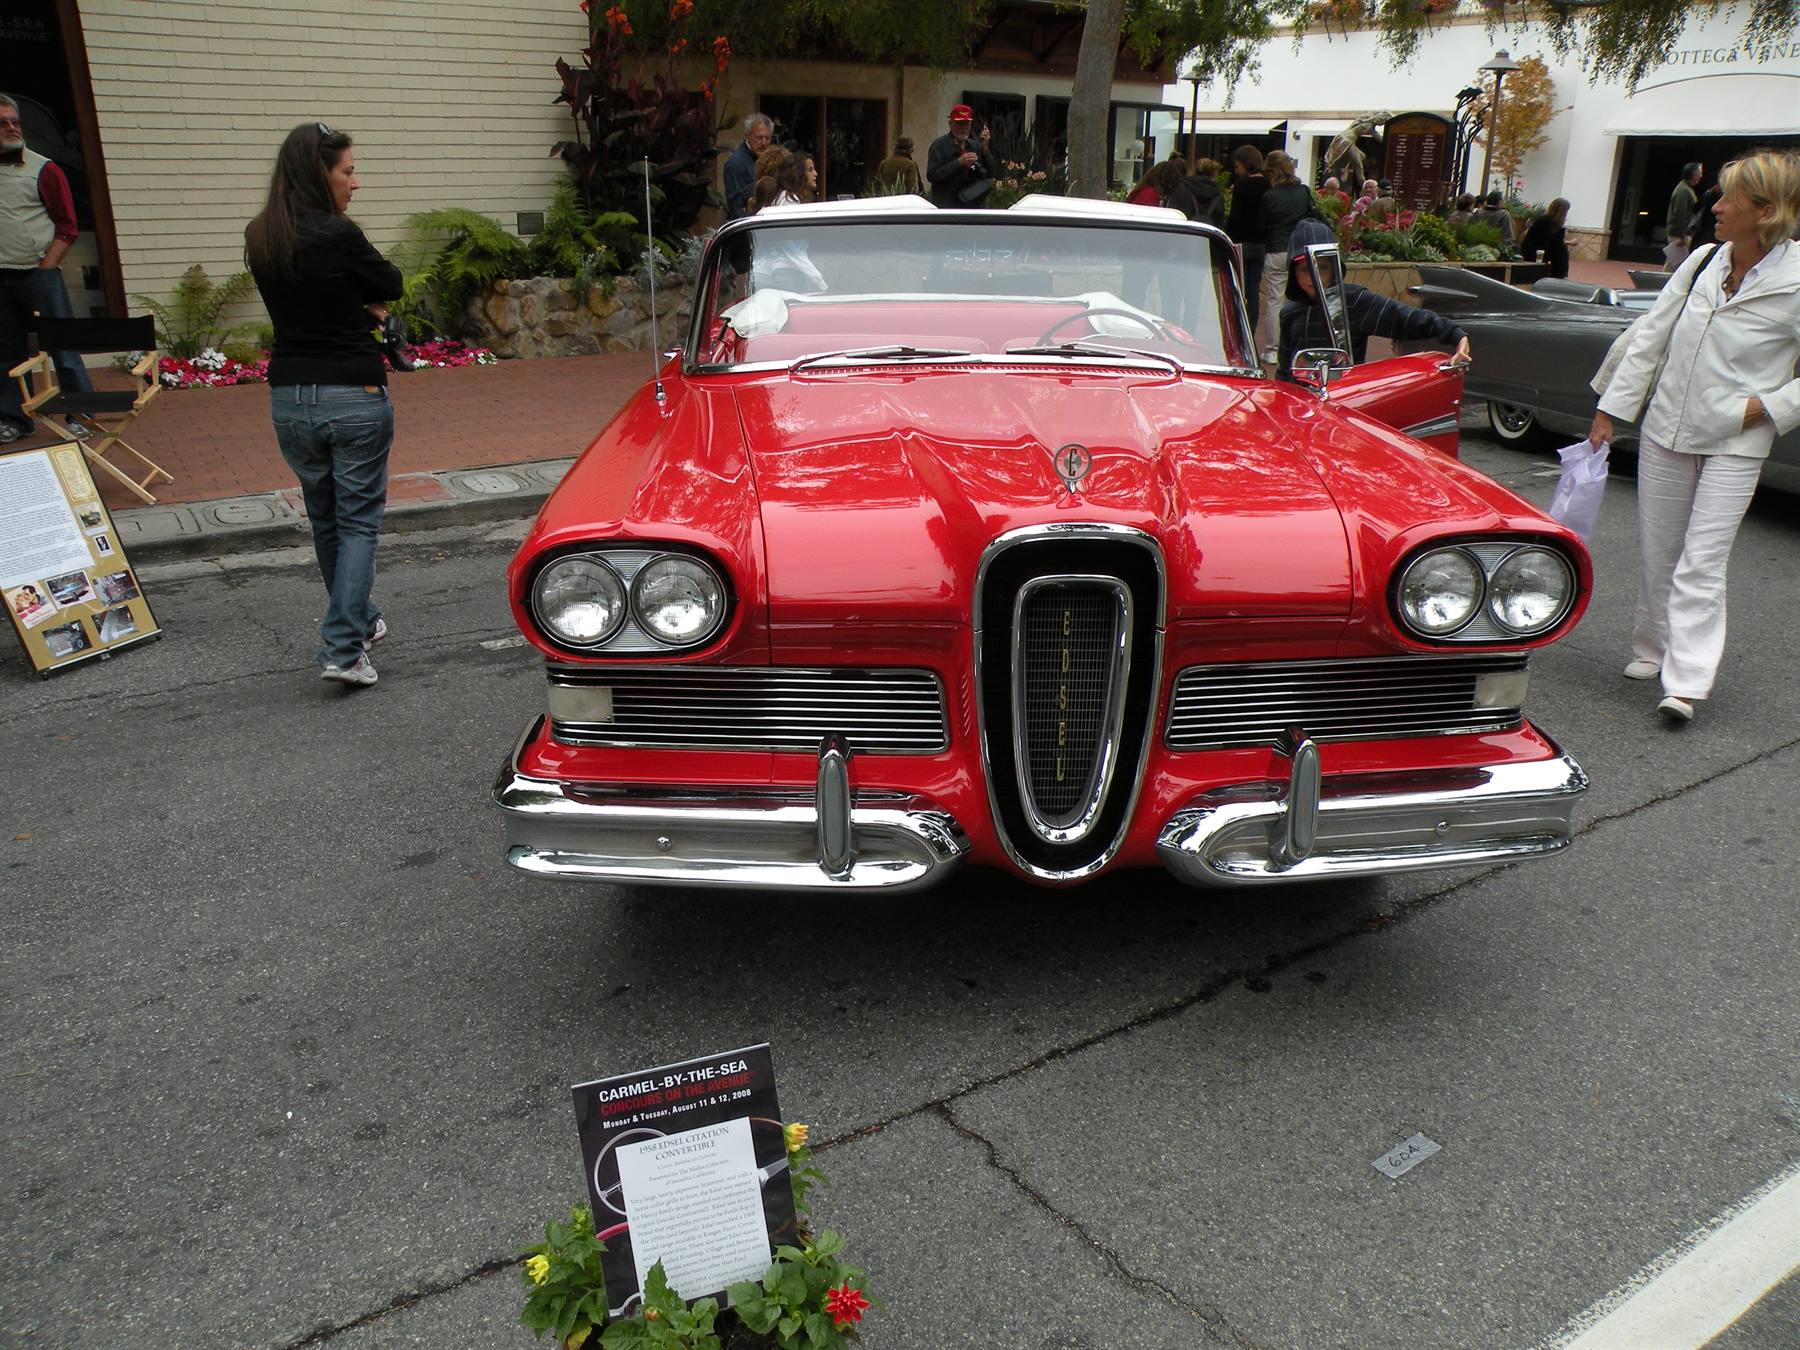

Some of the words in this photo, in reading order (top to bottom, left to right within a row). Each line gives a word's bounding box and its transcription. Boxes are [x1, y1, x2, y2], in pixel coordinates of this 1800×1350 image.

[1664, 47, 1738, 66] OTTEGA
[1056, 609, 1071, 782] EDSEL
[599, 1059, 748, 1103] CARMEL-BY-THE-SEA
[600, 1093, 663, 1116] CONCOURS
[666, 1088, 682, 1102] ON
[685, 1082, 706, 1098] THE
[632, 1113, 639, 1123] &
[699, 1099, 708, 1108] 11
[710, 1096, 717, 1105] &
[719, 1093, 731, 1104] 12,
[733, 1088, 752, 1100] 2008
[638, 1142, 657, 1154] 1958
[658, 1136, 683, 1150] EDSEL
[685, 1126, 729, 1144] CITATION
[654, 1139, 716, 1161] CONVERTIBLE
